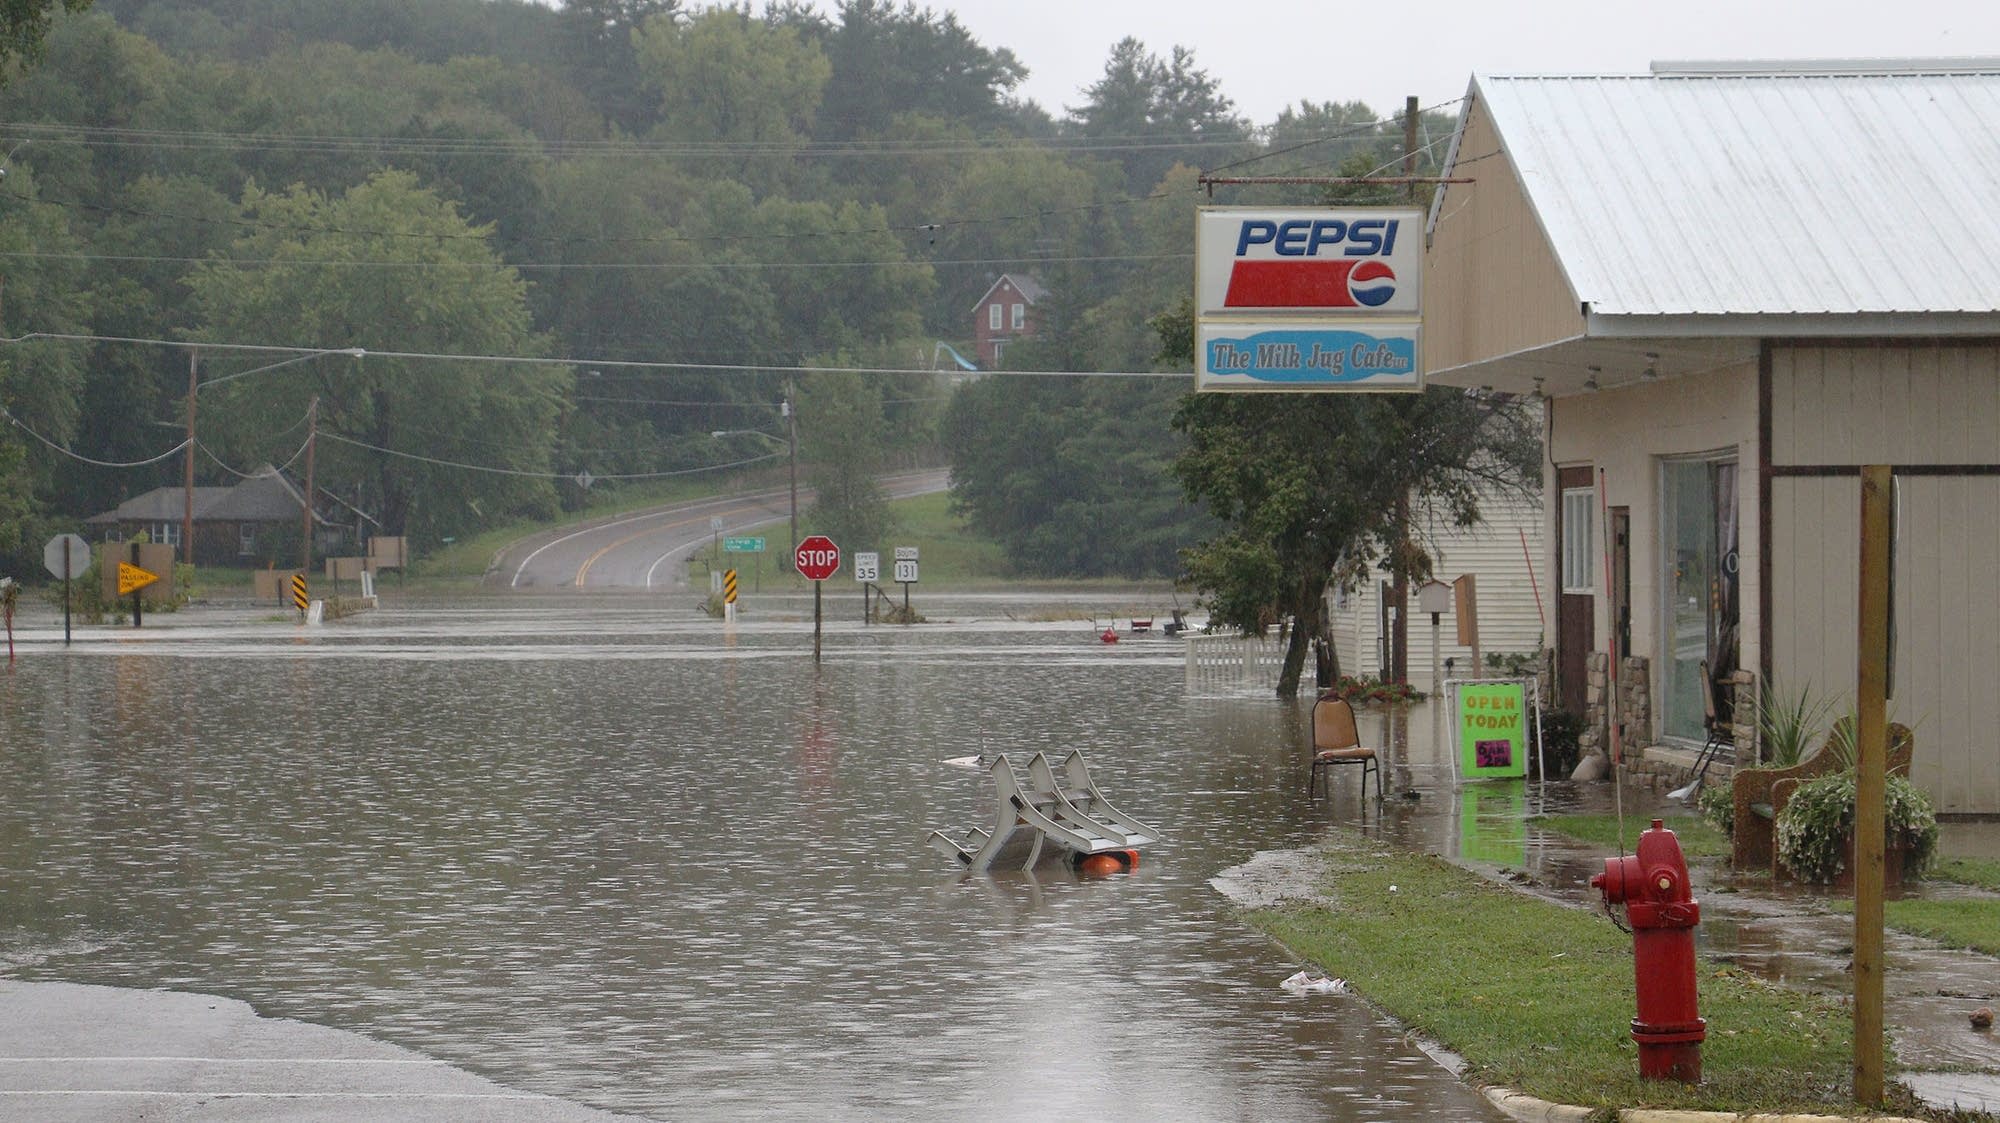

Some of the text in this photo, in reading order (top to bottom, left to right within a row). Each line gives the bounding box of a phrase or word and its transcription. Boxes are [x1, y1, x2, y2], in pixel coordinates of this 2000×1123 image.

[1236, 219, 1399, 256] PEPSI
[1214, 343, 1249, 368] The
[1255, 343, 1300, 368] Milk
[1307, 343, 1345, 376] Jug
[1351, 343, 1393, 368] Cafe
[798, 549, 836, 567] STOP
[896, 549, 917, 558] SOUTH
[858, 568, 876, 579] 35
[898, 564, 914, 578] 131
[1466, 696, 1515, 710] OPEN
[1465, 713, 1518, 729] TODAY
